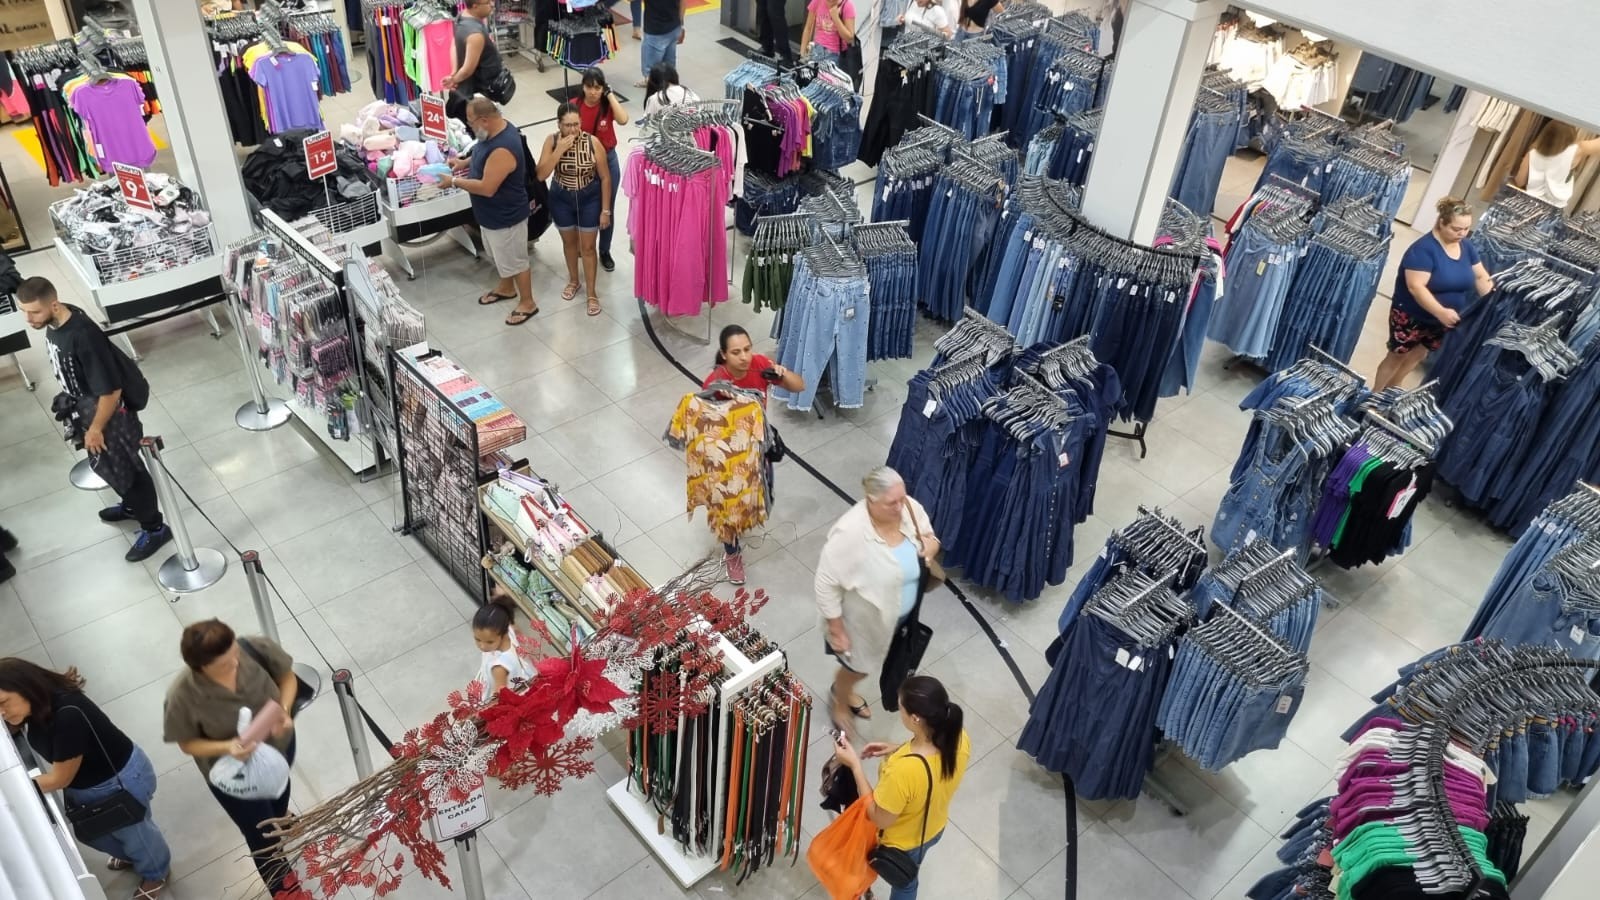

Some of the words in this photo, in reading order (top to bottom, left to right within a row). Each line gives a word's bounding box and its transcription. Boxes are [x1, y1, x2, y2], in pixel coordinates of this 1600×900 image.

[427, 111, 440, 124] 24
[314, 151, 327, 164] 19
[125, 180, 138, 199] 9
[438, 794, 482, 815] ENTRADA
[447, 805, 477, 820] CAIXA
